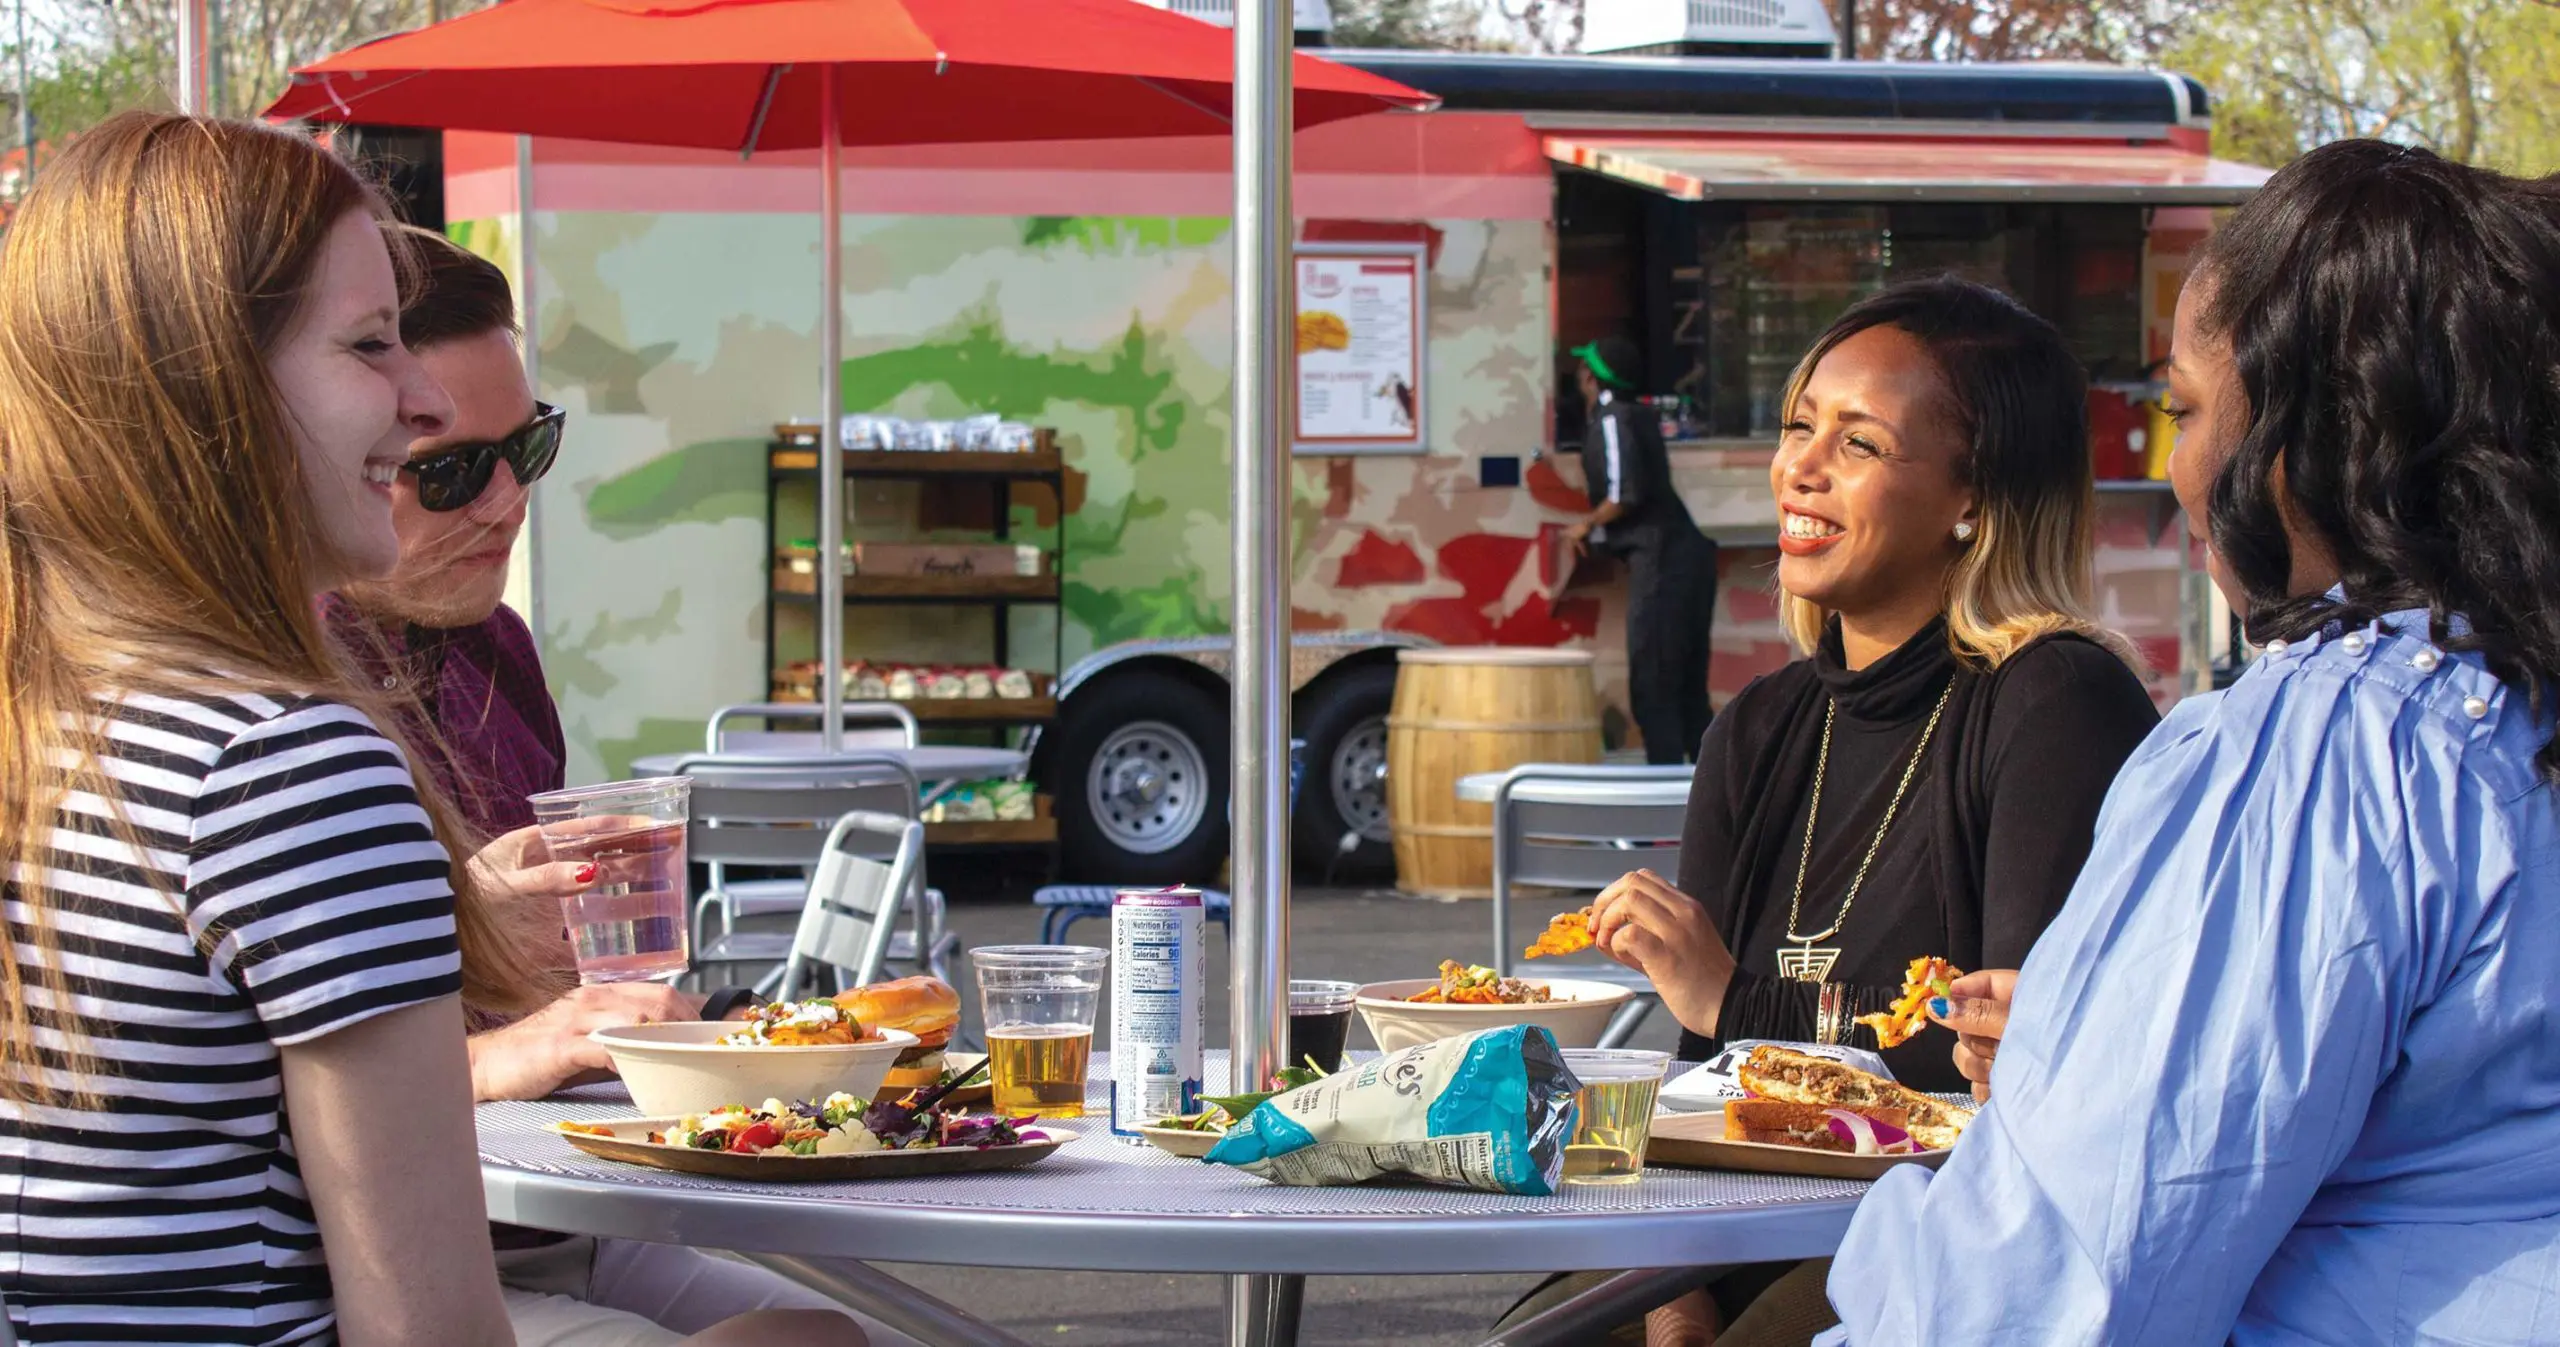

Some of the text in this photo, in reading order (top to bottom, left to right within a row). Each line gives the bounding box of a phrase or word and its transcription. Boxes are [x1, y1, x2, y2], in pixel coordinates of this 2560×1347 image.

[1133, 922, 1179, 930] Nutrition Facts
[1132, 948, 1180, 959] Calories 90
[1440, 1141, 1453, 1176] Calories
